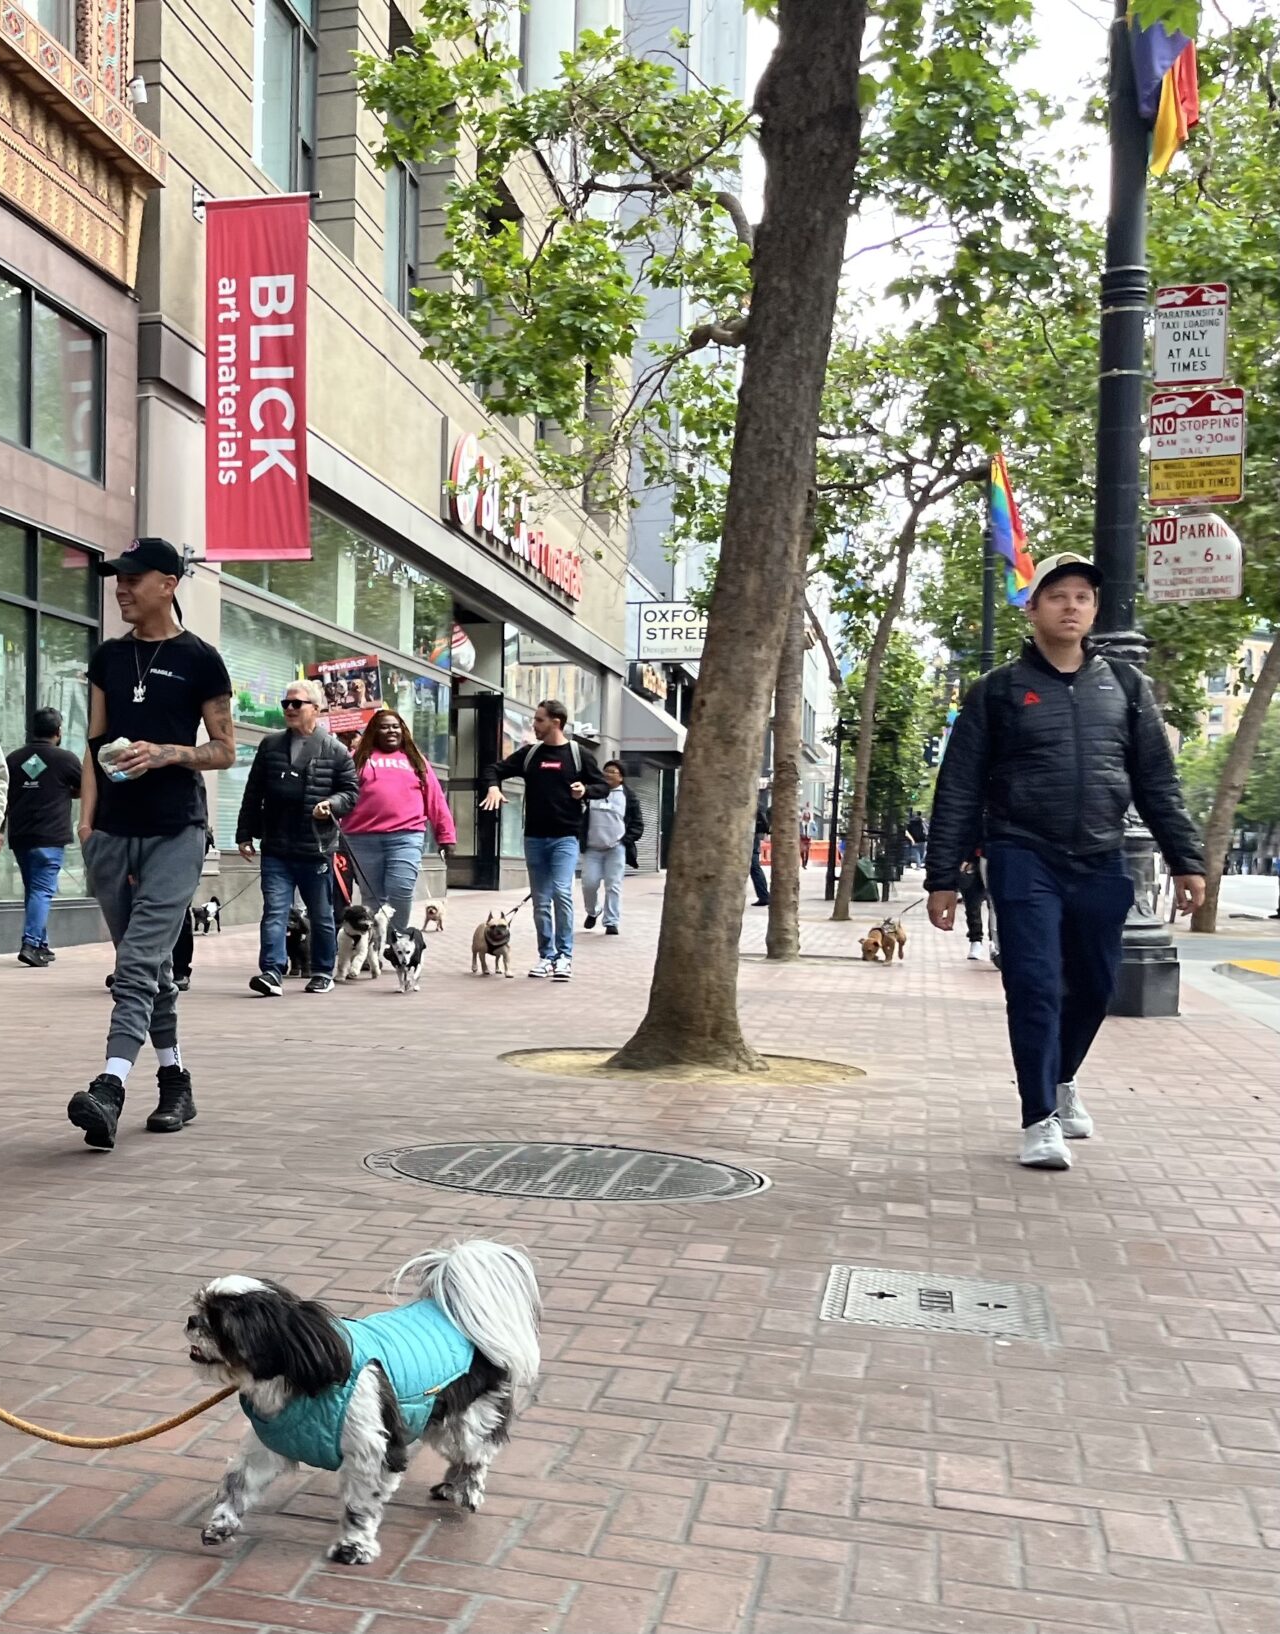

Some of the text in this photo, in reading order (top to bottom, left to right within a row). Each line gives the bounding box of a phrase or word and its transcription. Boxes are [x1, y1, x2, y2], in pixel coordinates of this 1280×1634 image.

[1158, 308, 1224, 319] PARATRANSIT &
[1161, 319, 1220, 330] TAXI LOADING
[1173, 330, 1207, 342] ONLY
[1168, 347, 1211, 359] AT ALL
[1171, 361, 1207, 373] TIMES
[217, 277, 242, 485] art materials
[248, 274, 296, 484] BLICK
[1152, 417, 1239, 434] NO STOPPING
[1180, 447, 1210, 455] DAILY
[1155, 477, 1236, 490] ALL OTHER TIMES
[1150, 521, 1174, 543] NO
[528, 532, 546, 575] art
[643, 646, 677, 654] Designer
